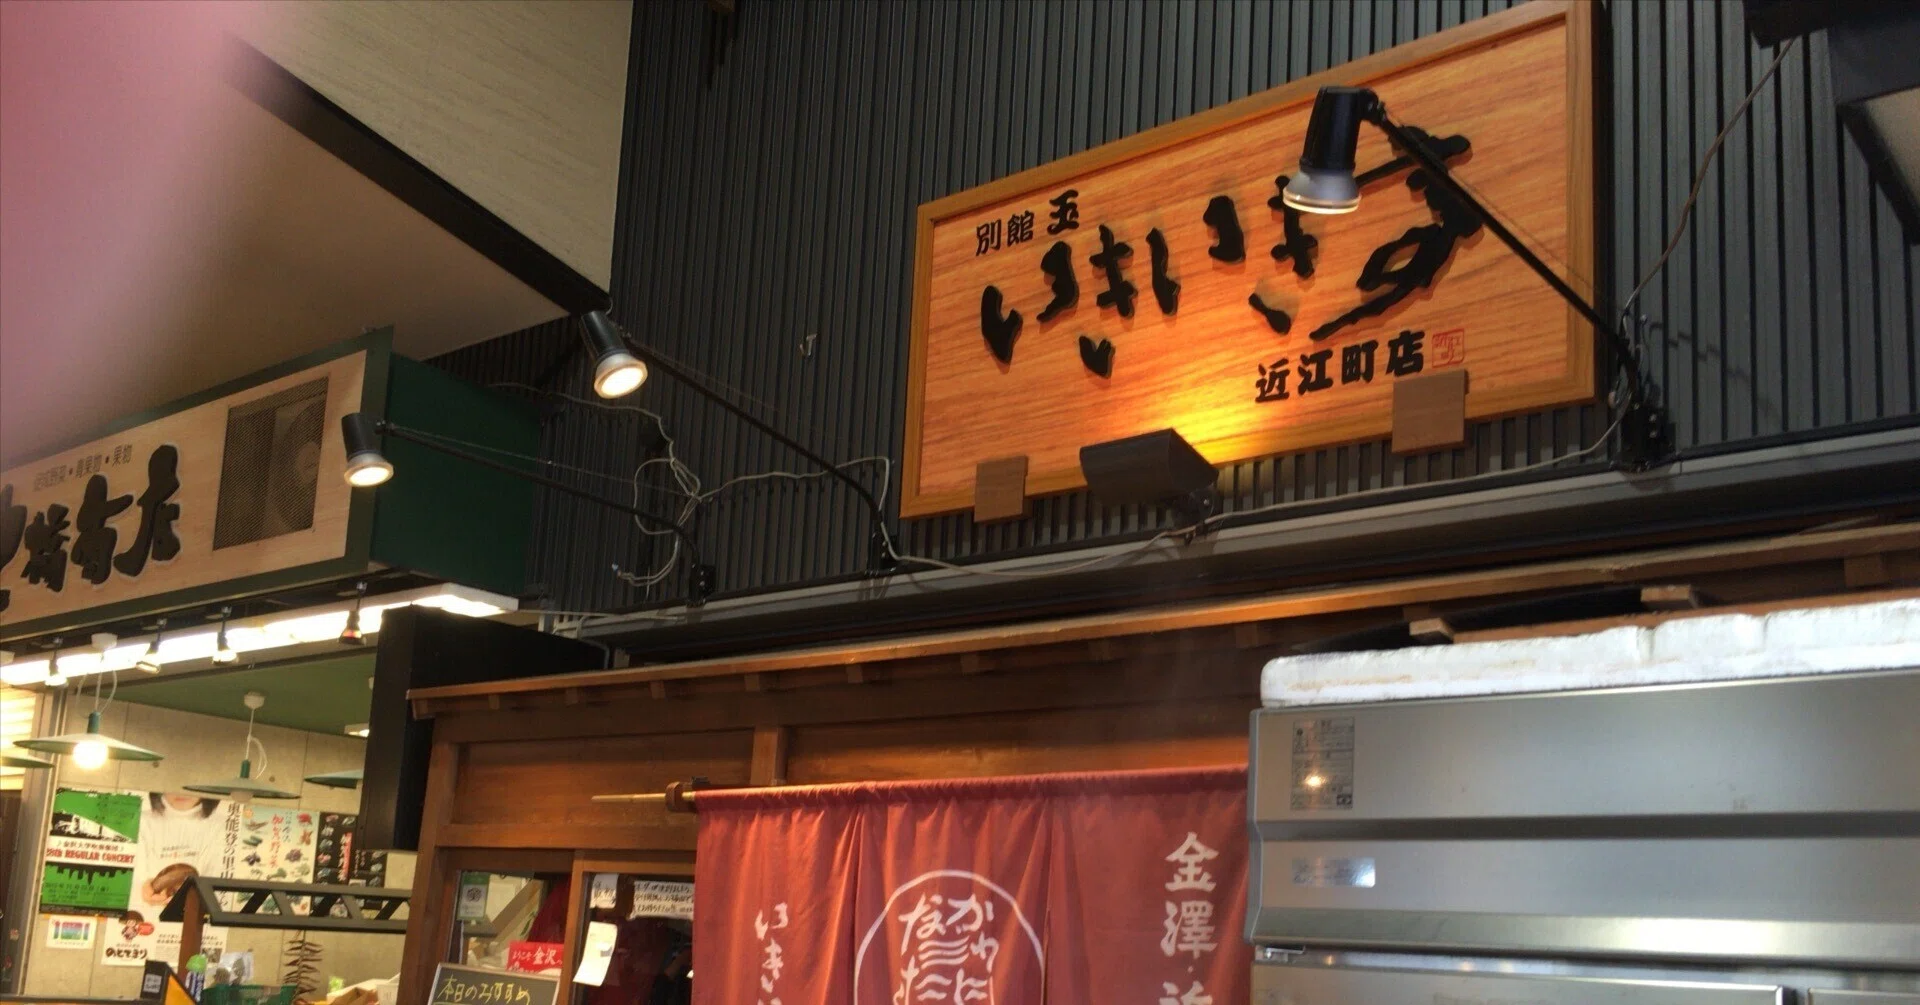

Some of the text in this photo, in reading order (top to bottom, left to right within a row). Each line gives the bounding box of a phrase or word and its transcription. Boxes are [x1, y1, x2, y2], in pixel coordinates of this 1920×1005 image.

[976, 211, 1035, 256] 別館
[1255, 330, 1425, 403] 近江町店
